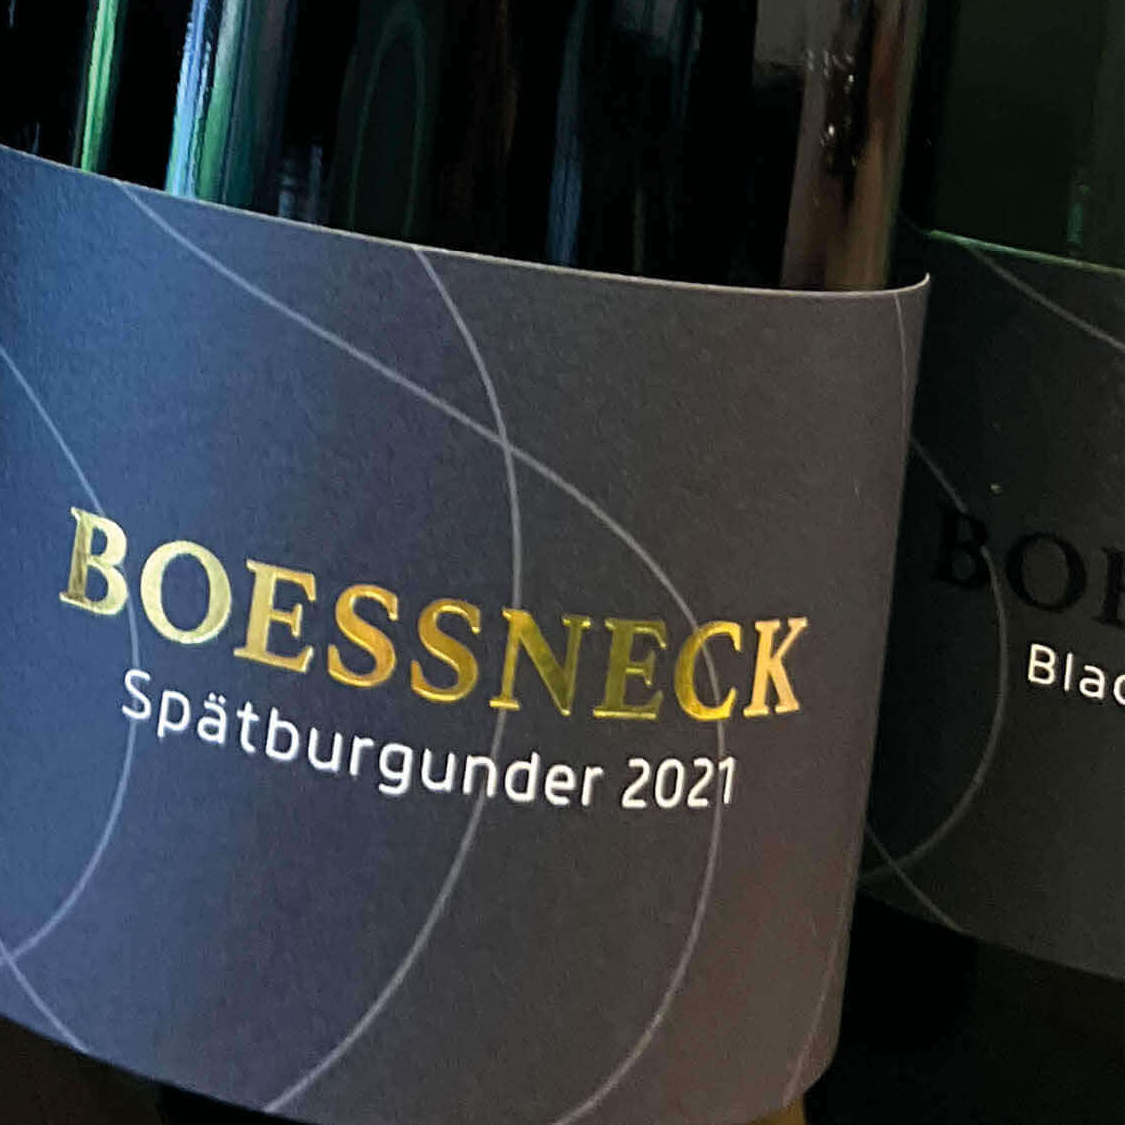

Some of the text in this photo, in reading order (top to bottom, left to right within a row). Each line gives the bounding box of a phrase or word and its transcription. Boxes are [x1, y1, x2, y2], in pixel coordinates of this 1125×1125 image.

[58, 506, 810, 722] BOESSNECK
[121, 669, 738, 808] Spätburgunder 2021
